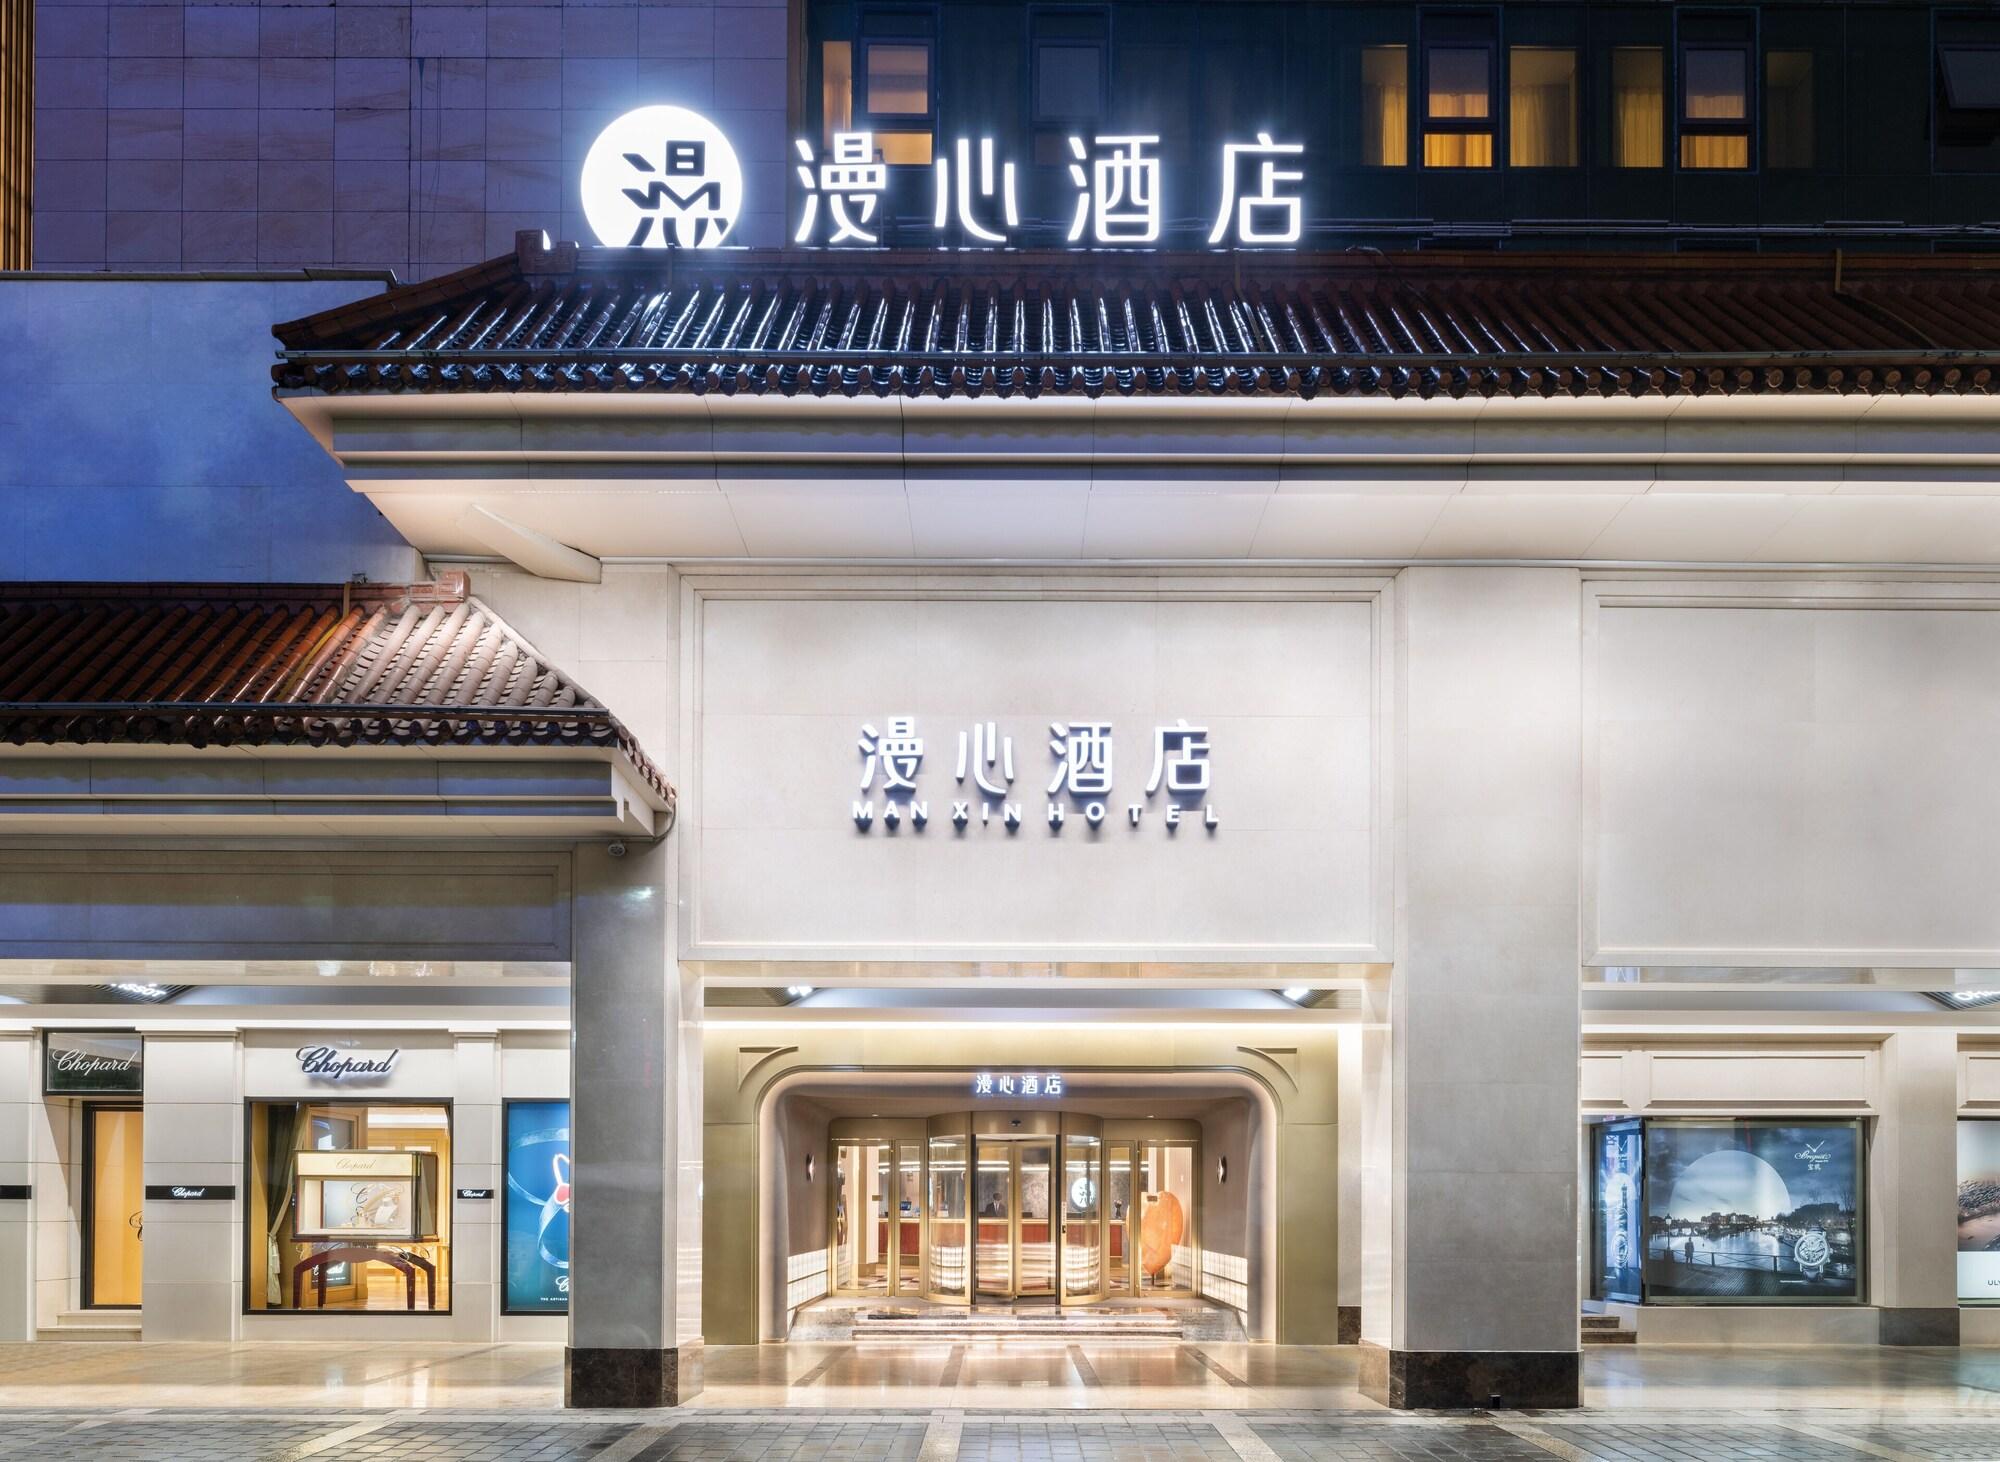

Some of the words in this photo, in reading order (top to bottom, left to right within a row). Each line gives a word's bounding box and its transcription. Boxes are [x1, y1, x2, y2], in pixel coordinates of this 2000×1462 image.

[794, 131, 1306, 246] 漫心酒店
[857, 716, 1212, 797] 漫心酒店
[852, 800, 929, 823] MAN
[952, 801, 1023, 824] XIN
[1047, 801, 1220, 825] HOTEL
[52, 1048, 138, 1076] Chopard
[295, 1045, 400, 1079] Chopard
[975, 1074, 1062, 1095] 漫心酒店
[171, 1186, 206, 1199] Chopard
